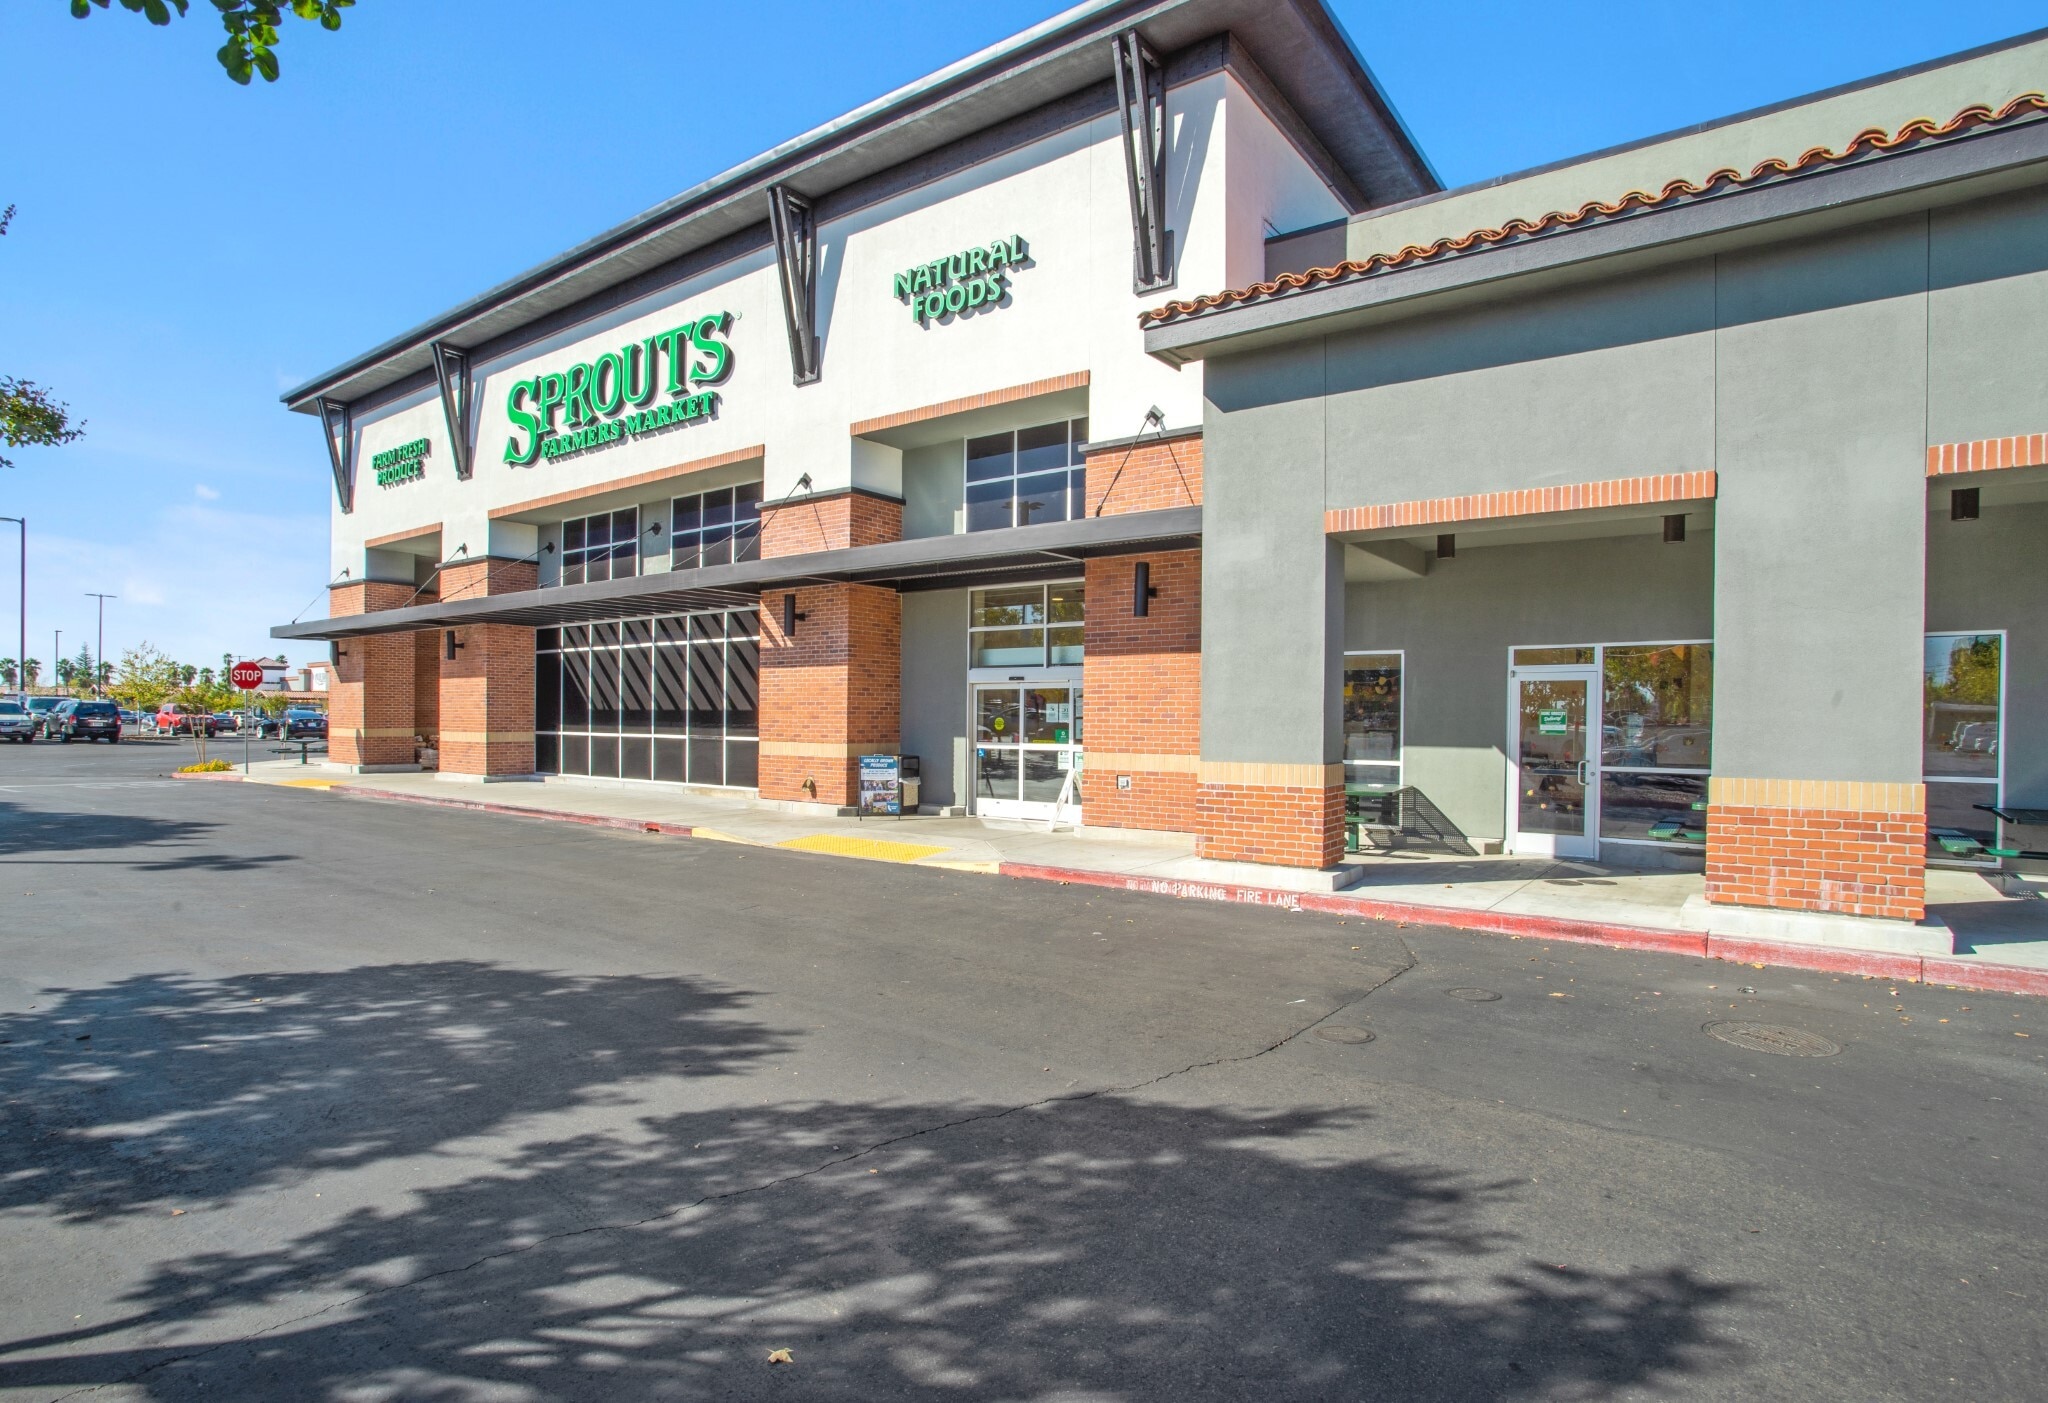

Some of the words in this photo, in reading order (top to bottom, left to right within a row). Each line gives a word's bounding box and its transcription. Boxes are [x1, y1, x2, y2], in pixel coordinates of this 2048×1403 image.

[894, 234, 1027, 298] NATURAL
[913, 273, 1005, 323] FOODS
[503, 311, 733, 466] SPROUTS
[541, 419, 622, 458] FARMERS
[625, 391, 716, 435] MARKET
[372, 448, 398, 470] FARM
[398, 438, 428, 460] FRESH
[377, 459, 420, 486] PRODUCE
[233, 670, 262, 681] STOP
[1151, 880, 1168, 893] NO
[1174, 882, 1226, 901] PARKING
[1236, 889, 1263, 904] FIRE
[1268, 893, 1300, 908] LANE
